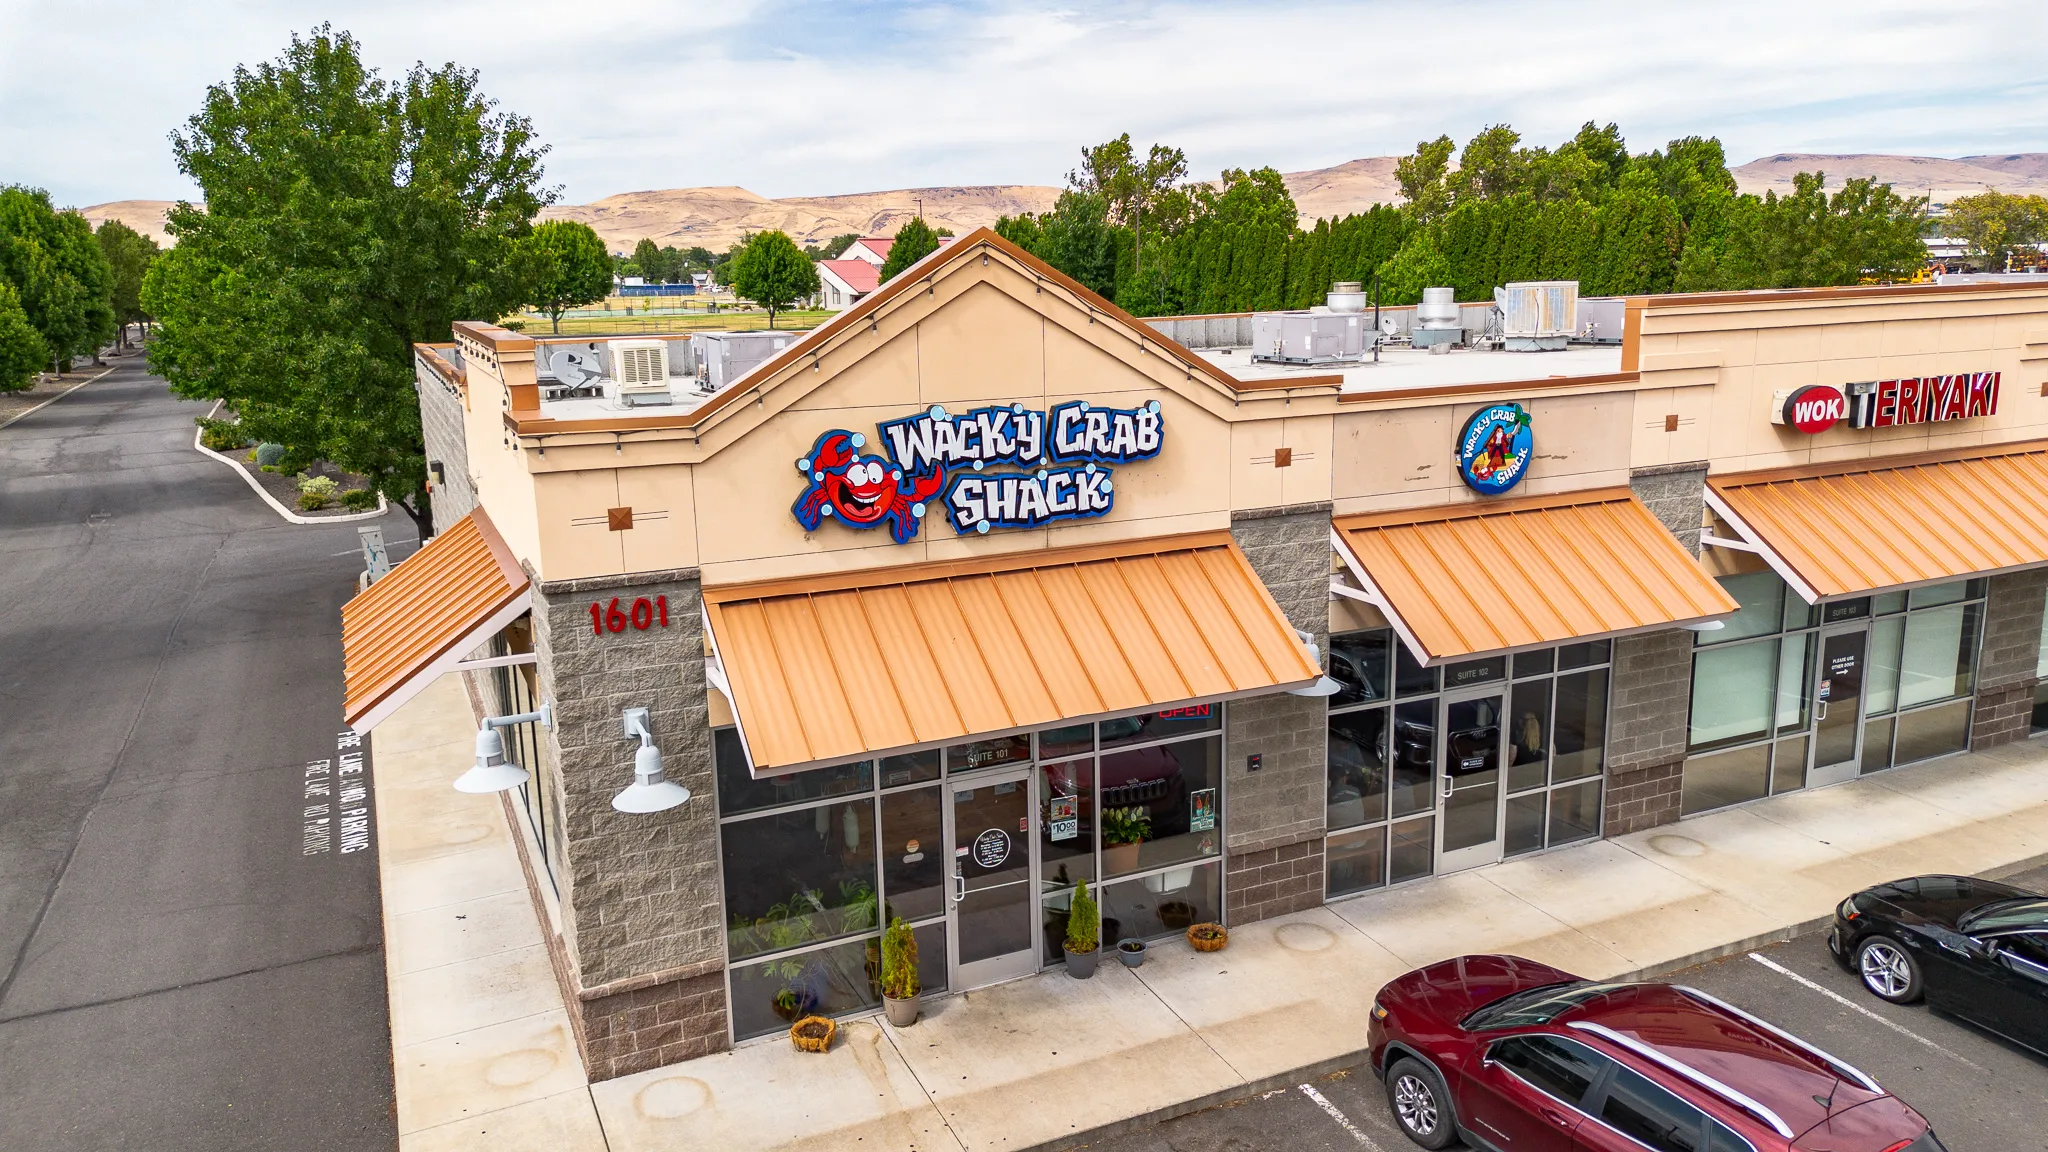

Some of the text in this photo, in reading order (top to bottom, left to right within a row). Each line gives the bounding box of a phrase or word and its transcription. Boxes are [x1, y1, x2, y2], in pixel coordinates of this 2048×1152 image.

[1795, 398, 1841, 424] WOK
[1845, 371, 2002, 429] TERIYAKI
[1490, 408, 1516, 423] CRAB
[887, 405, 1163, 471] WACKY CRAB
[1496, 447, 1529, 485] SHACK
[951, 471, 1110, 527] SHACK
[588, 594, 669, 635] 1601
[1831, 662, 1844, 670] OTHER
[1832, 656, 1847, 664] PLEASE
[1457, 667, 1489, 680] SUITE 102
[337, 730, 361, 750] FIRE
[338, 751, 364, 776] LANE
[995, 748, 1008, 759] 101
[302, 759, 331, 855] FIRE LANE NO PARKING
[341, 807, 369, 855] PARKING
